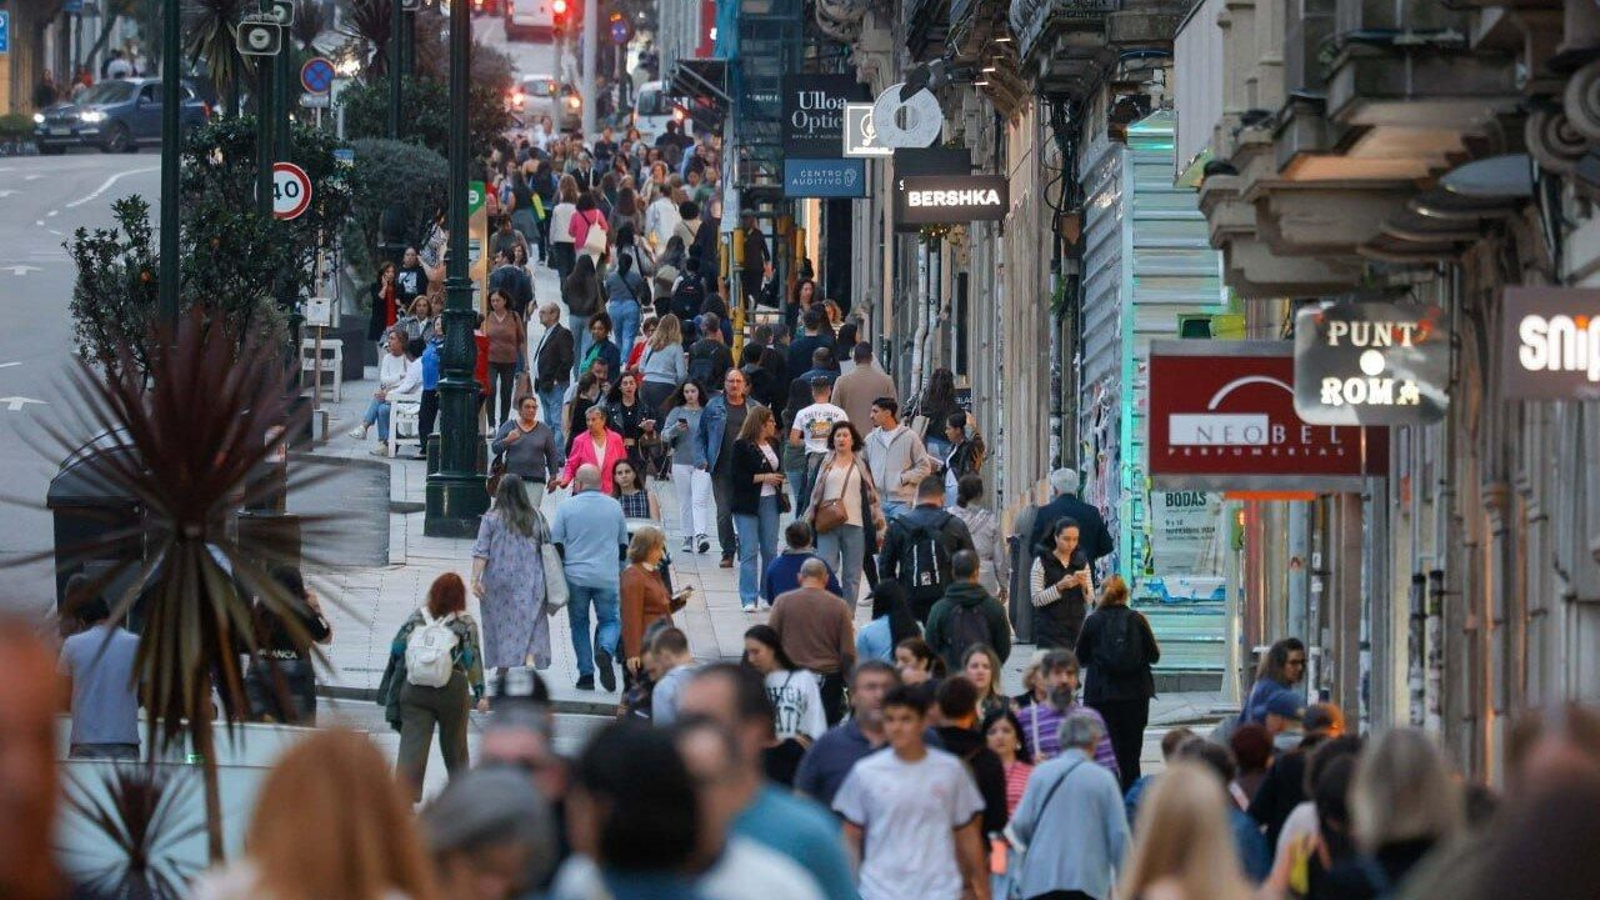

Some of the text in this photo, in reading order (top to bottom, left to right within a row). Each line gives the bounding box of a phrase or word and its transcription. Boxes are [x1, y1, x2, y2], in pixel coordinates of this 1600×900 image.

[797, 91, 847, 109] Ulloa
[792, 178, 842, 186] AUDITIVO
[908, 189, 1001, 207] BERSHKA
[1320, 377, 1421, 406] ROMA
[1197, 425, 1342, 445] NEOBEL
[1168, 448, 1345, 457] PERFUMERIAS
[1165, 491, 1207, 507] BODAS
